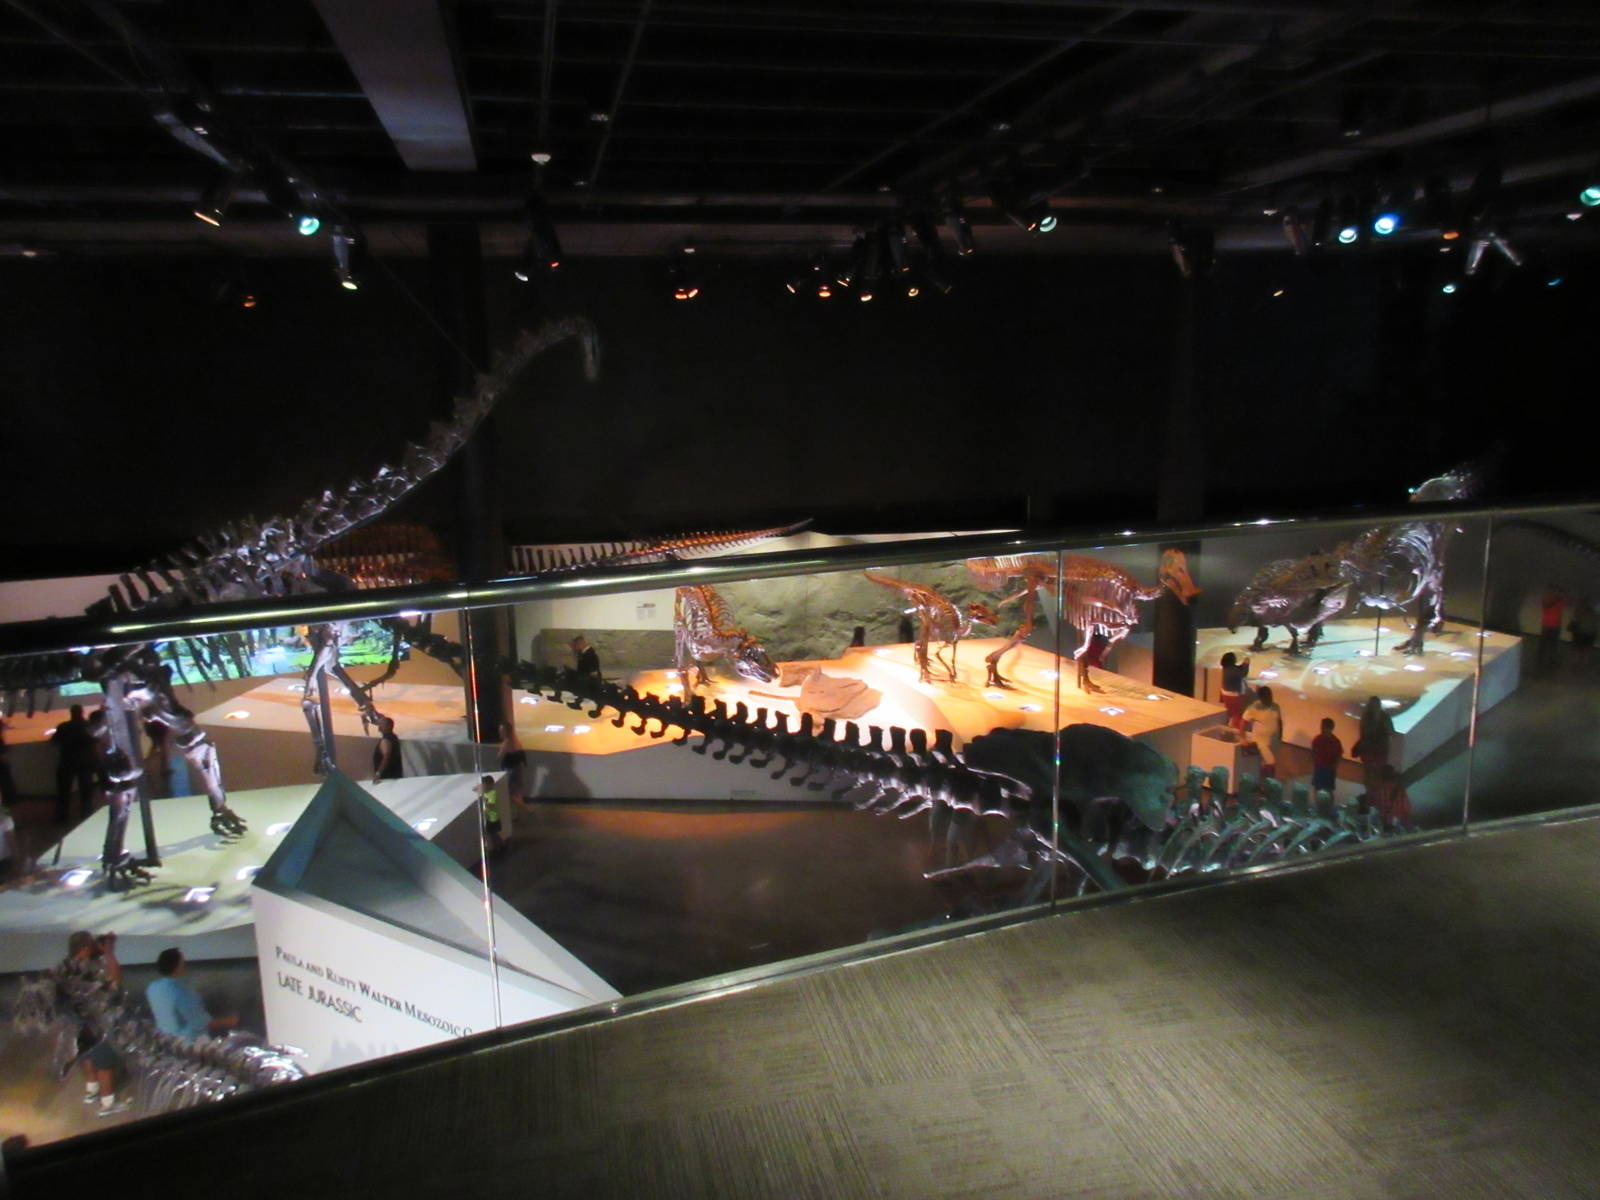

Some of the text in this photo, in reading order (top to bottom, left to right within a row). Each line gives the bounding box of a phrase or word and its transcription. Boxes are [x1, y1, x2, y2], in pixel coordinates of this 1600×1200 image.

[277, 971, 362, 1023] LATE JURASSIC
[306, 963, 324, 977] AND
[326, 967, 356, 992] RUSTY
[358, 980, 402, 1012] WALTER
[404, 1000, 461, 1038] MESOZOIC
